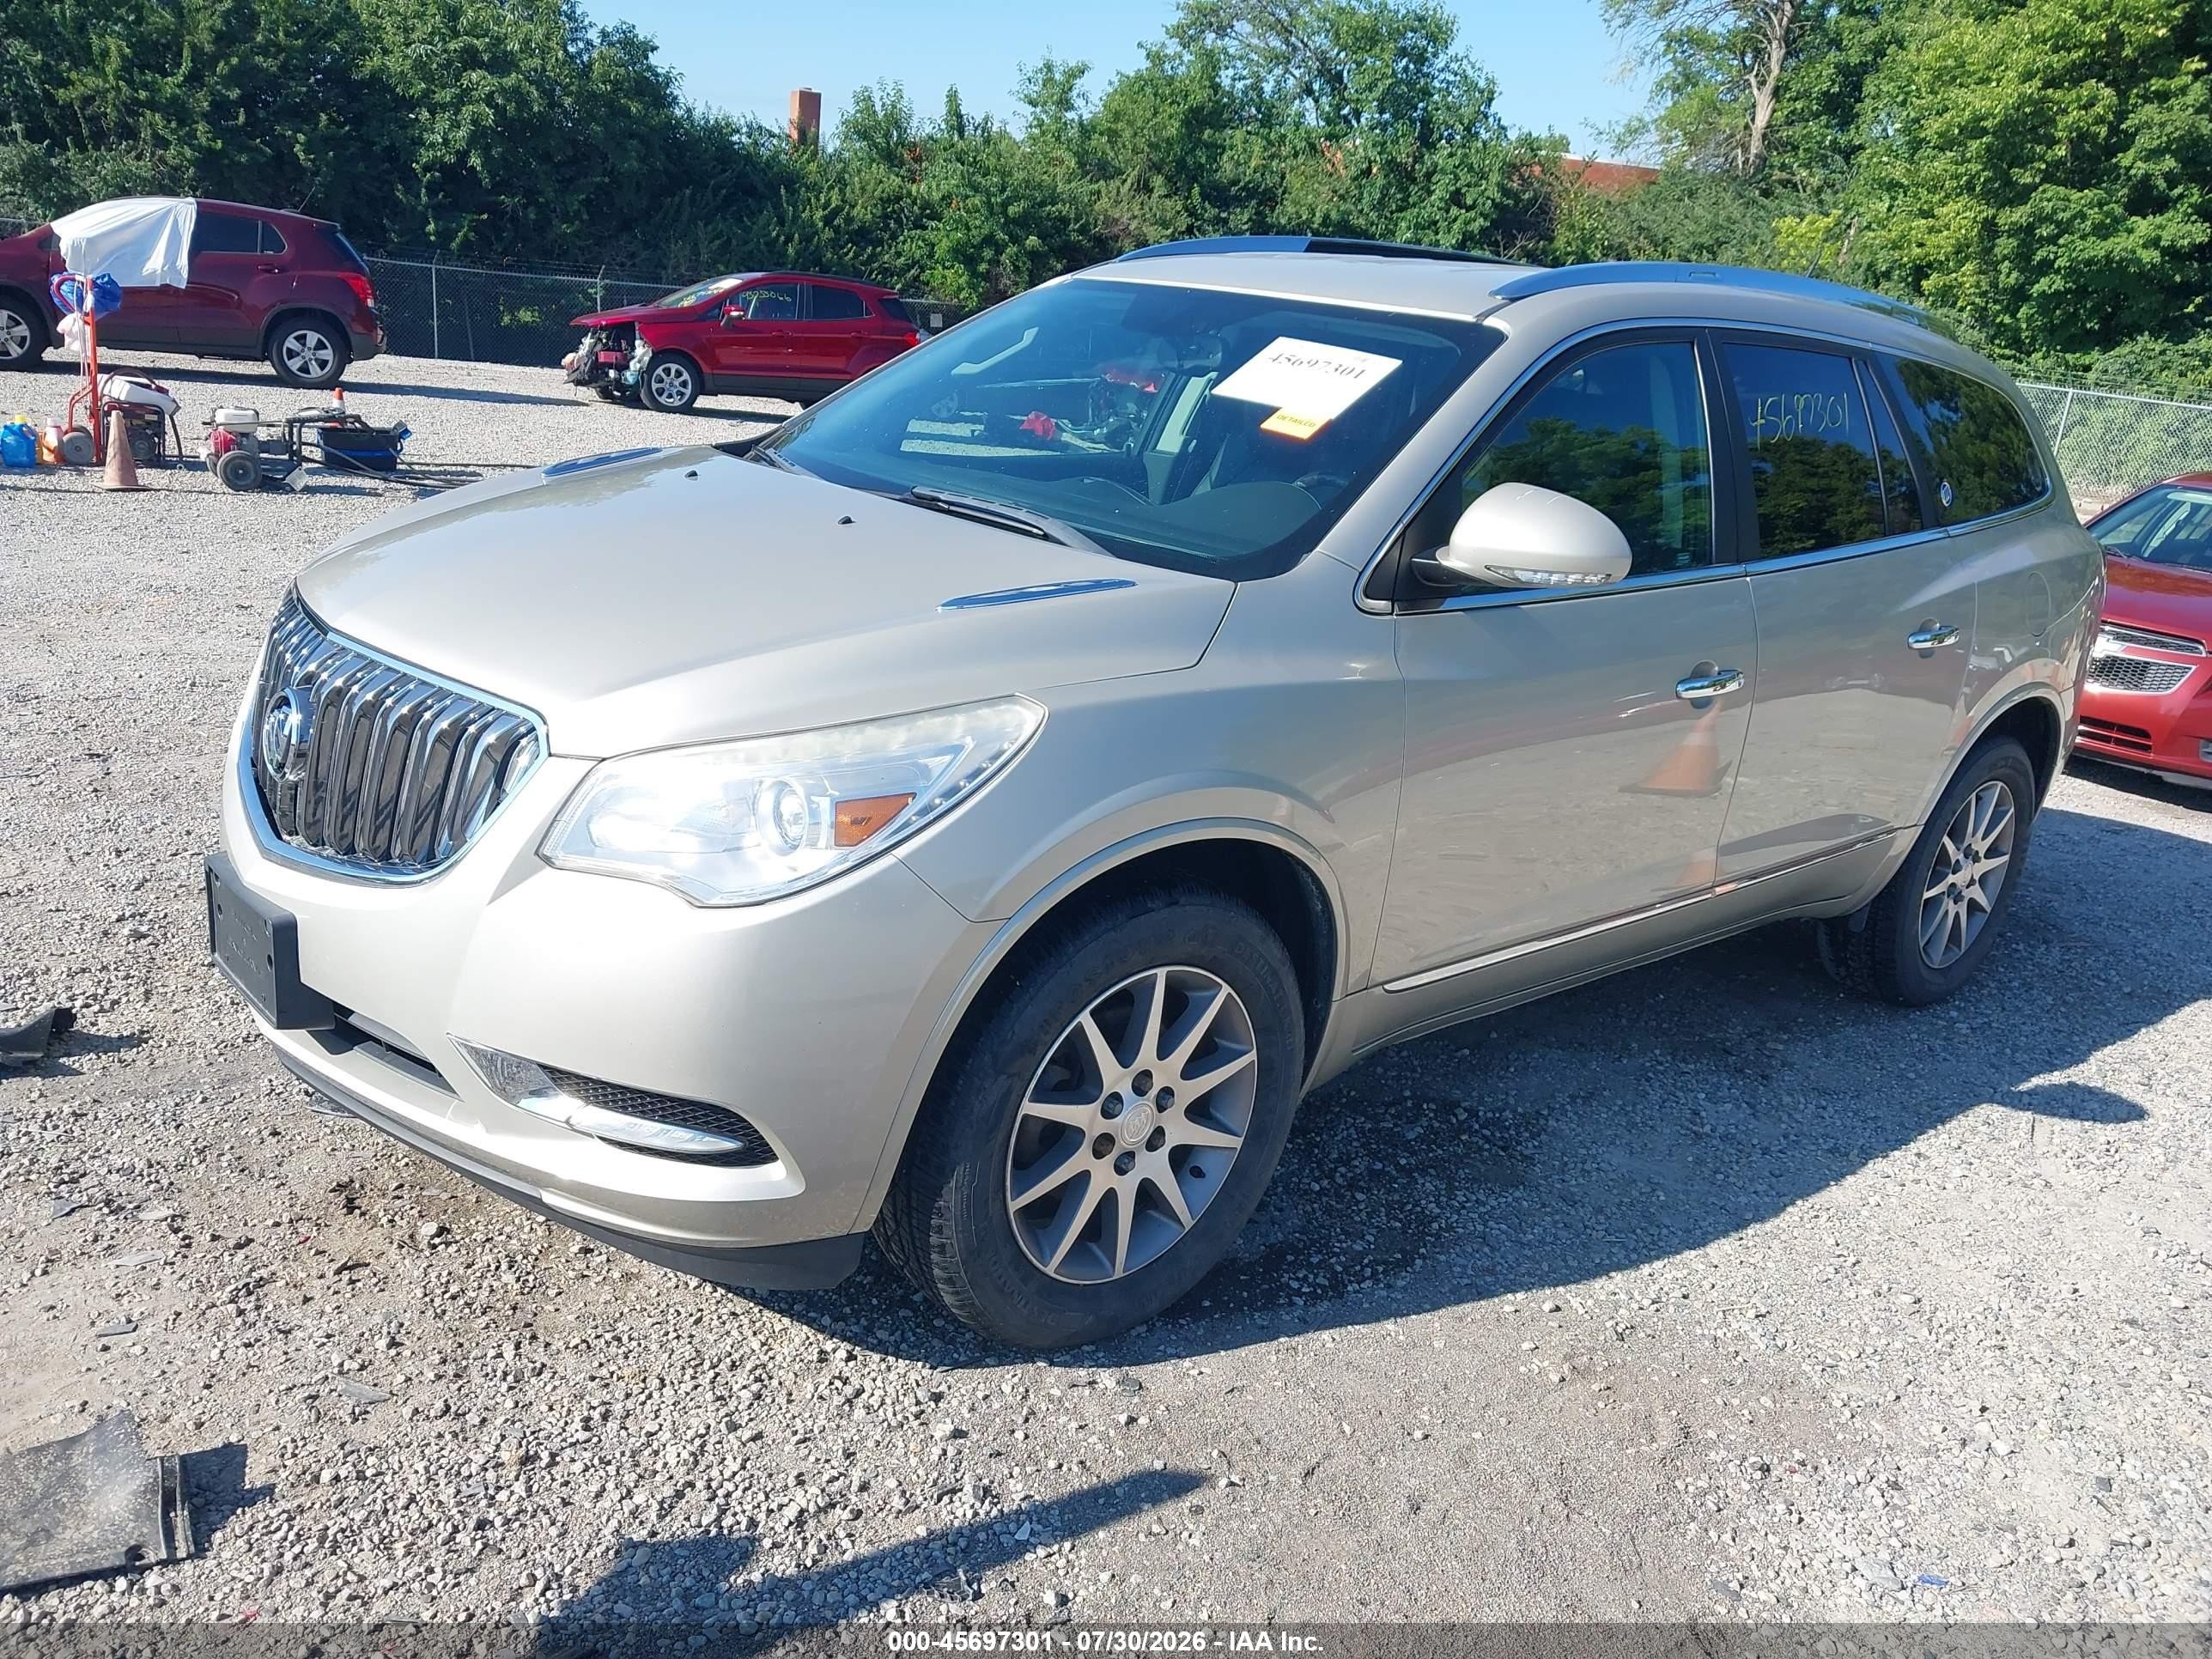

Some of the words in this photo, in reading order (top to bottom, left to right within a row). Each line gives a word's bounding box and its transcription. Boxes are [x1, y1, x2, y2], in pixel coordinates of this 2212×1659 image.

[1267, 352, 1368, 379] 45697301
[1276, 414, 1317, 428] DETAILED
[1748, 392, 1849, 451] 45697301
